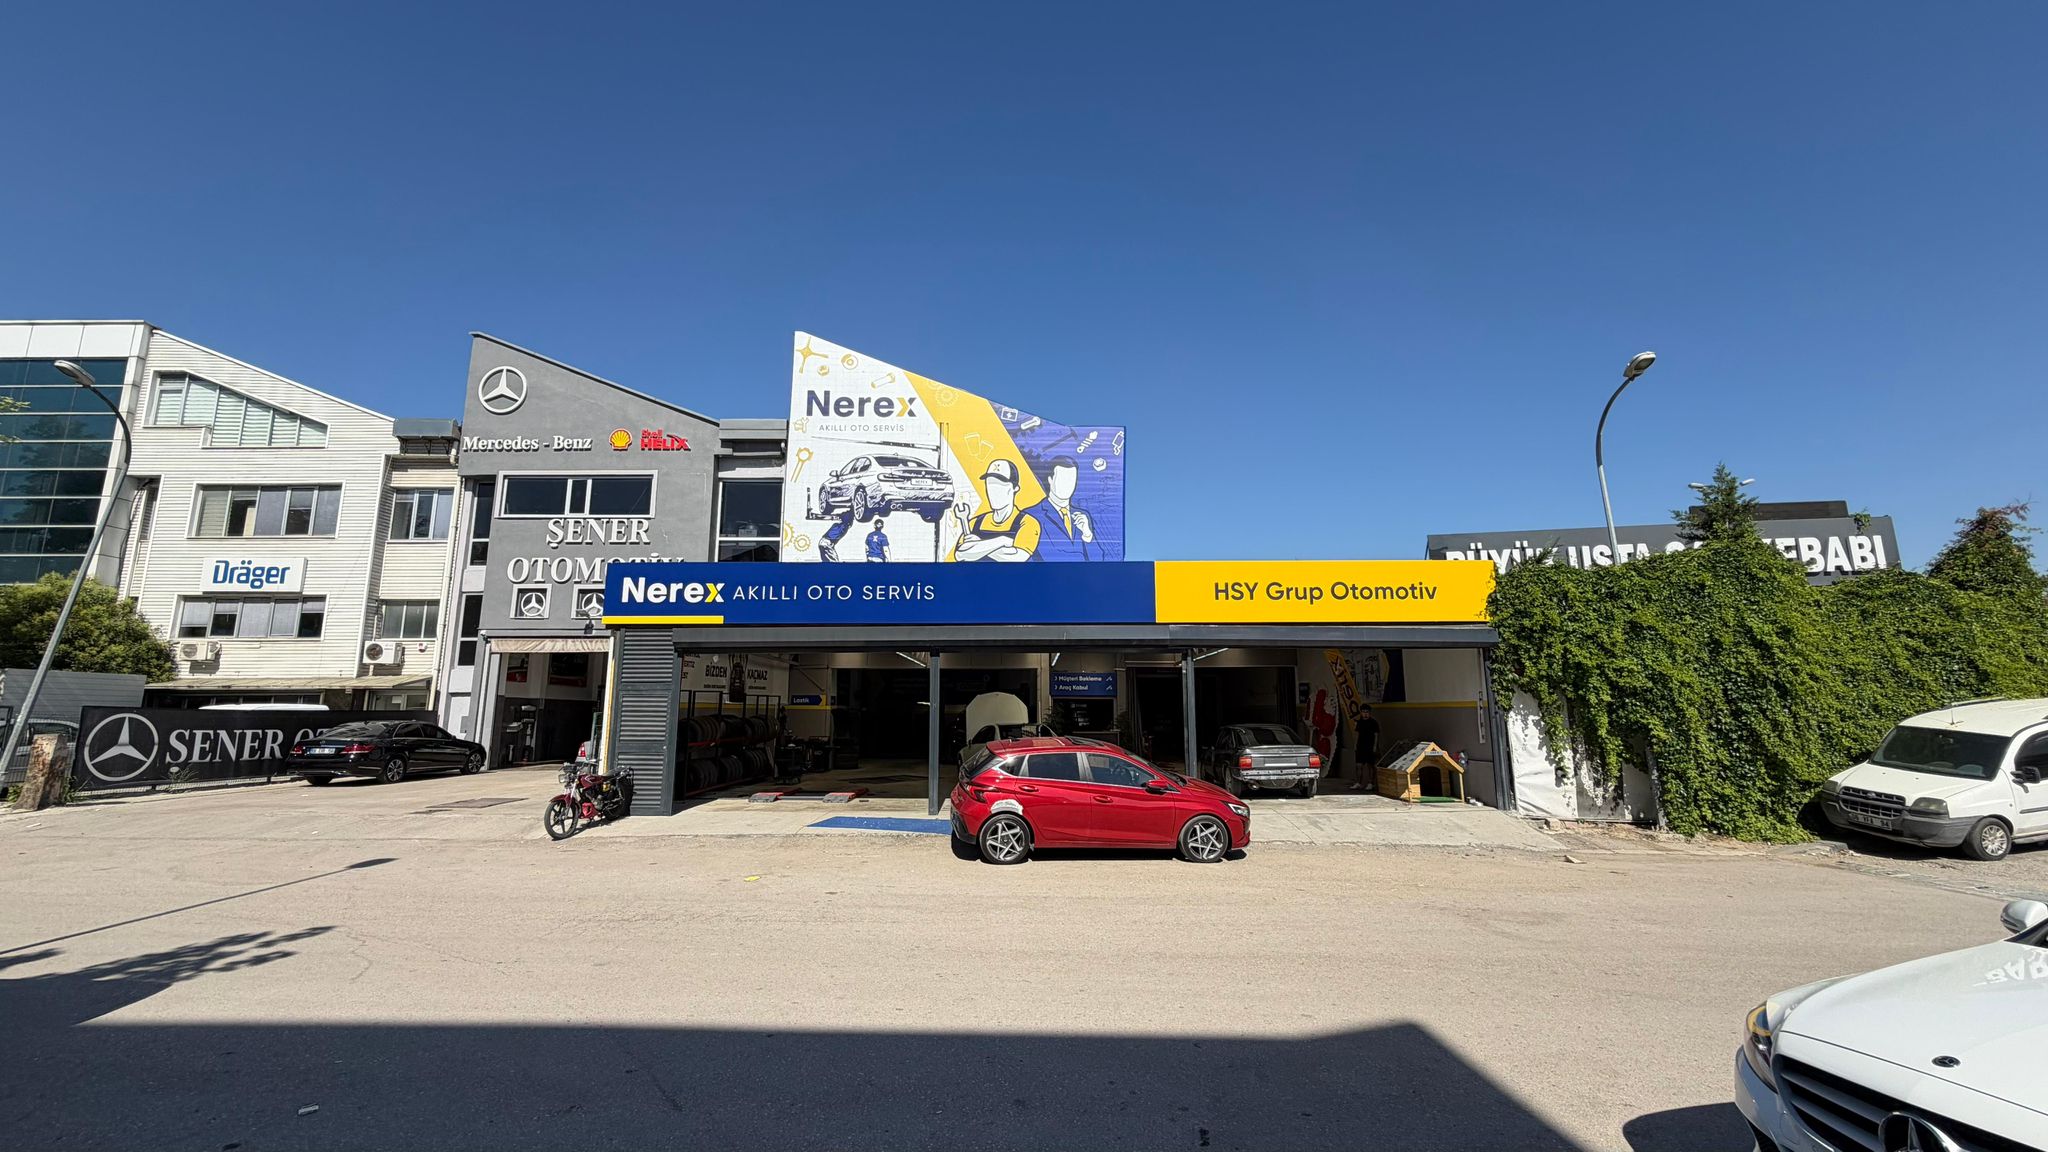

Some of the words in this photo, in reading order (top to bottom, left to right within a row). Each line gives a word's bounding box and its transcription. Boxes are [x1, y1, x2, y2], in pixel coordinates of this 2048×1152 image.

[806, 390, 917, 417] Nerex
[641, 429, 663, 438] Shell
[819, 424, 847, 432] AKILLI
[849, 424, 870, 432] OTO
[873, 423, 905, 432] SERVİS
[462, 436, 539, 450] Mercedes
[552, 435, 592, 450] Benz
[640, 437, 691, 451] HELIX
[546, 519, 651, 549] ŞENER
[1762, 535, 1887, 572] EBABI
[212, 559, 291, 589] Dräger
[621, 576, 725, 603] Nerex
[732, 585, 798, 600] AKILLI
[807, 585, 852, 600] OTO
[862, 582, 936, 600] SERVİS
[1214, 582, 1259, 600] HSY
[1266, 582, 1324, 604] Grup
[1330, 581, 1437, 600] Otomotiv
